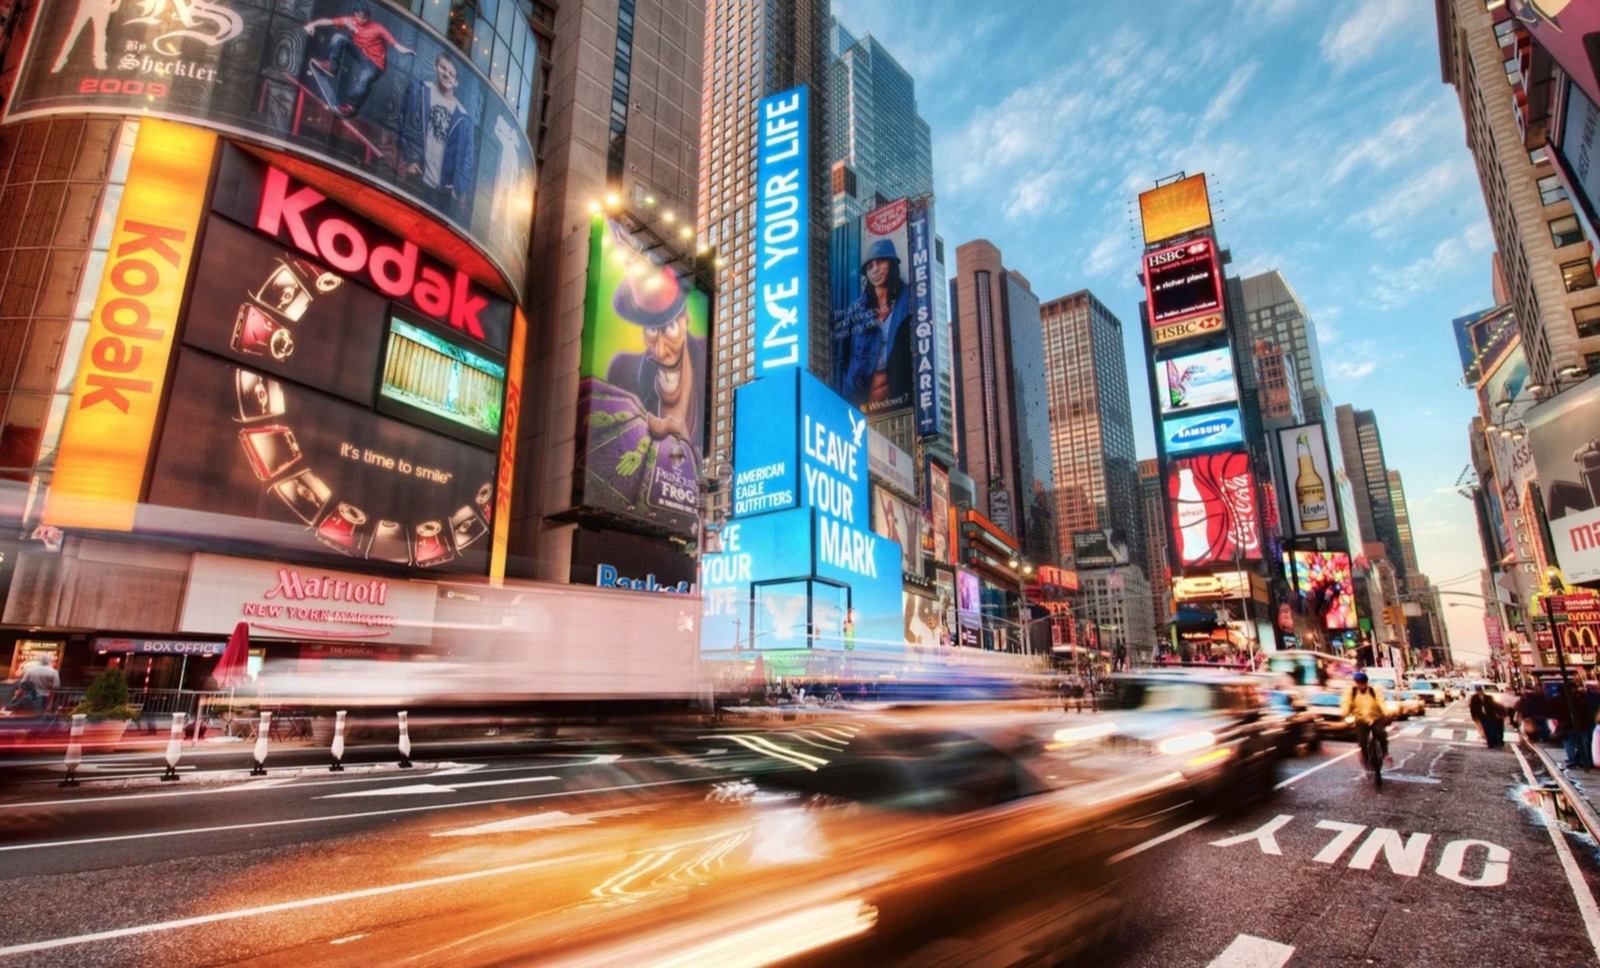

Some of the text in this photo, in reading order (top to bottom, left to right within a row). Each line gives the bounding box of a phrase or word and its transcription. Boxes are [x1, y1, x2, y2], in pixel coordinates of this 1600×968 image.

[124, 39, 147, 52] By
[78, 78, 168, 97] 2009
[766, 92, 800, 165] LIFE
[764, 169, 800, 270] YOUR
[256, 166, 491, 342] Kodak
[909, 218, 930, 299] TIMES
[1148, 248, 1186, 268] HSBC
[1162, 277, 1186, 289] richer
[1187, 271, 1209, 284] place
[79, 219, 188, 416] Kodak
[1155, 321, 1198, 340] HSBC
[915, 306, 933, 409] SQUARE
[868, 392, 909, 411] Windows 7
[498, 379, 520, 513] Kodak
[1178, 423, 1229, 439] SAMSUNG
[340, 442, 360, 460] It's
[363, 449, 395, 469] time
[398, 459, 412, 474] to
[804, 414, 859, 483] LEAVE
[736, 462, 785, 484] AMERICAN
[660, 480, 697, 504] FROG
[735, 490, 793, 515] OUTFITTERS
[736, 481, 765, 500] EAGLE
[804, 463, 854, 525] YOUR
[1302, 504, 1325, 515] Light
[820, 516, 878, 580] MARK
[701, 553, 752, 587] YOUR
[265, 568, 389, 605] Marriott
[703, 586, 738, 617] LIFE
[243, 602, 284, 617] NEW
[288, 606, 329, 622] YORK
[143, 640, 171, 652] BOX
[174, 641, 220, 654] OFFICE
[1207, 814, 1512, 887] ONLY
